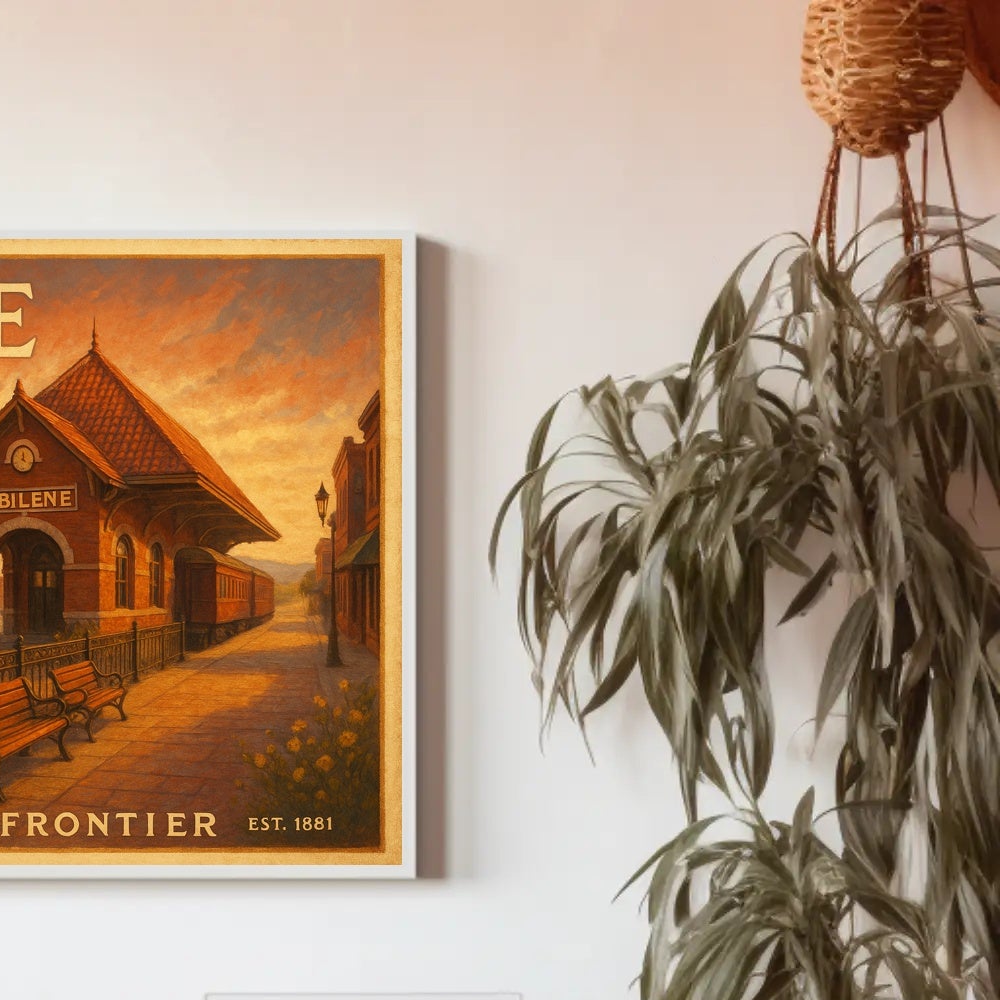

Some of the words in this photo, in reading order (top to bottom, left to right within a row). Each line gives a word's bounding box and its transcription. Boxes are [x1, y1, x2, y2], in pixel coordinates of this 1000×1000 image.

[1, 811, 218, 837] FRONTIER
[248, 817, 287, 832] EST.
[294, 816, 333, 832] 1881
